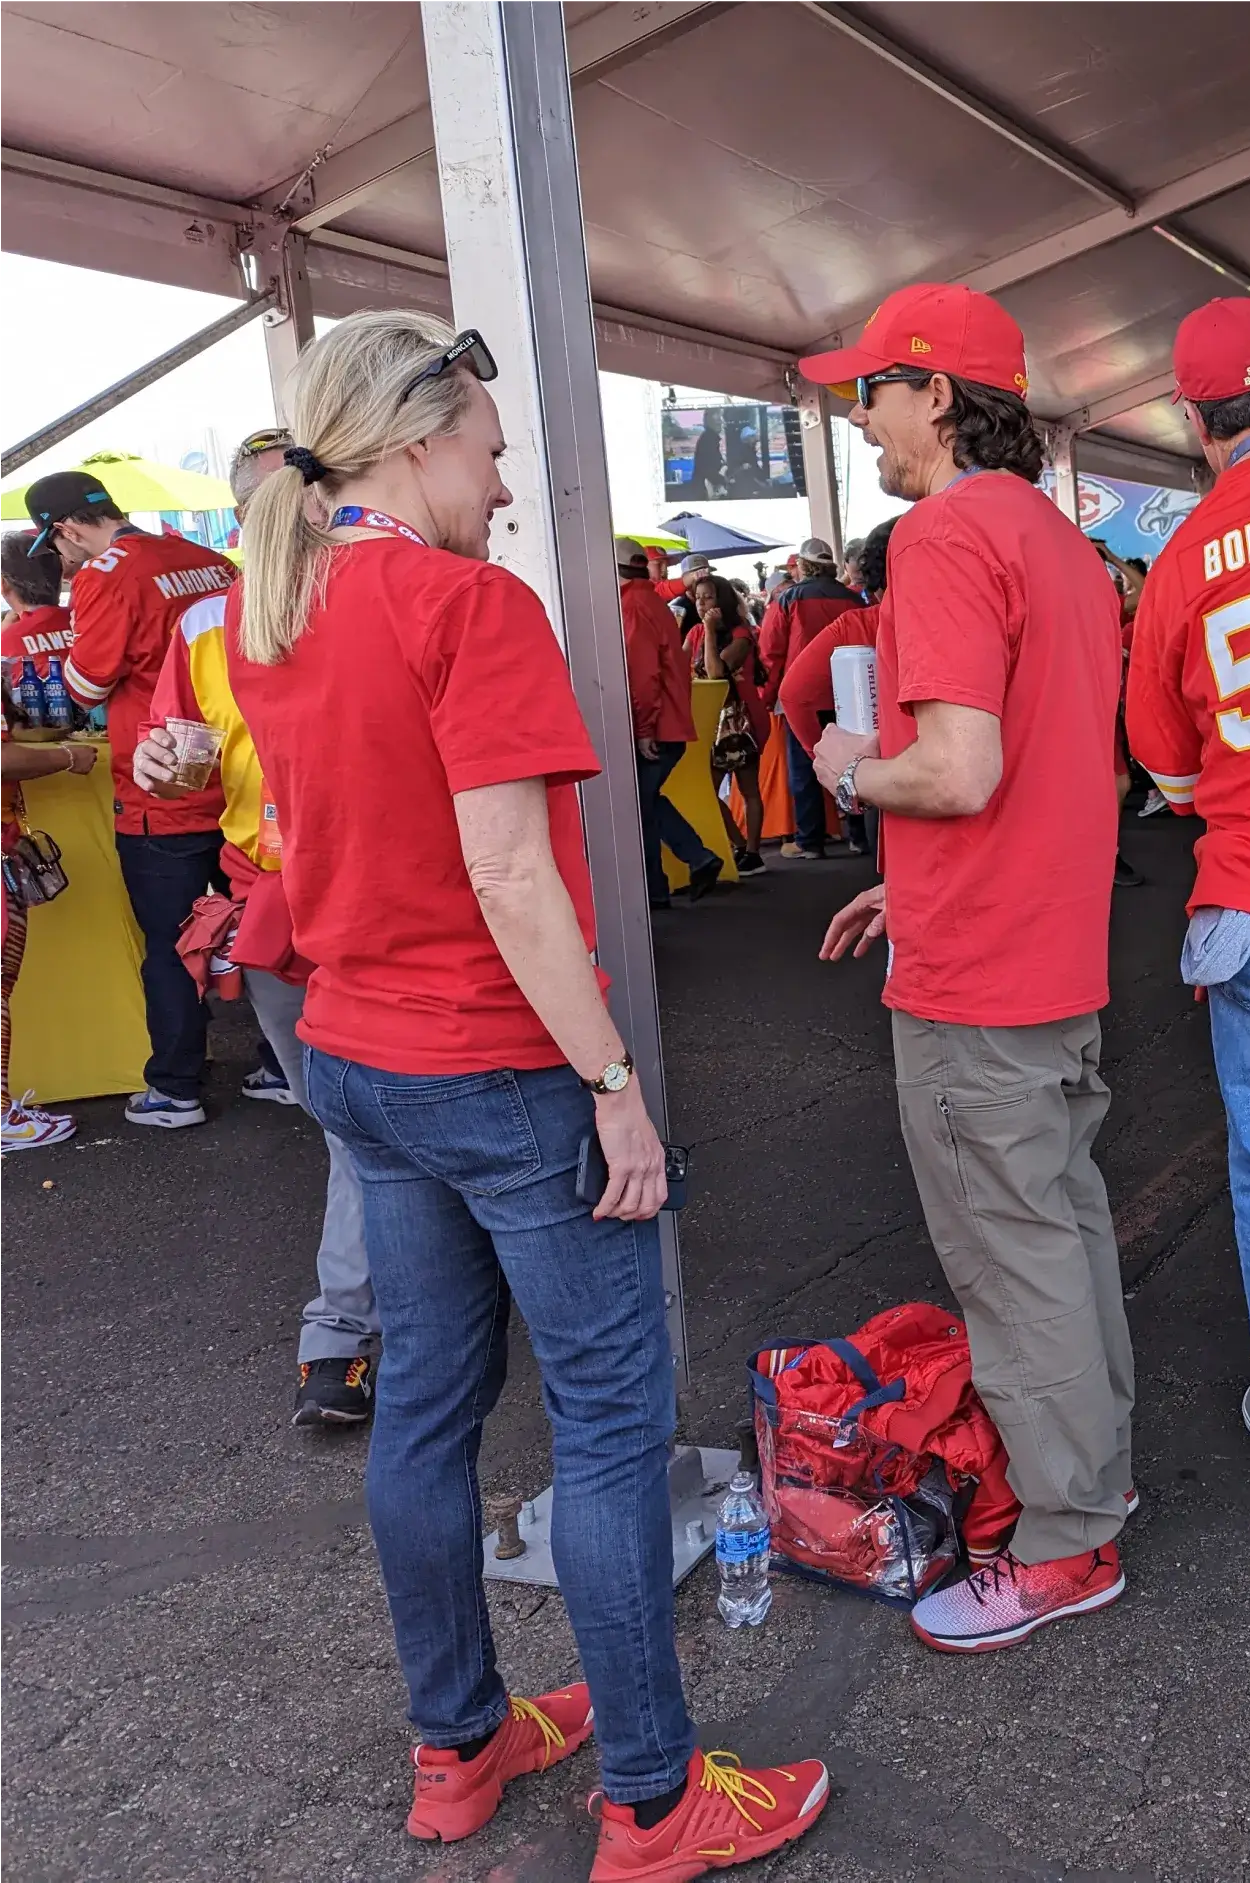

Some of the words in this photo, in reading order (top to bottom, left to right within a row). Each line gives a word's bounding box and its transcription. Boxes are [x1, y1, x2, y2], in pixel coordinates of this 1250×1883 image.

[446, 336, 476, 361] MONCLER
[152, 565, 233, 600] MAHOMES
[867, 663, 876, 700] STELLA
